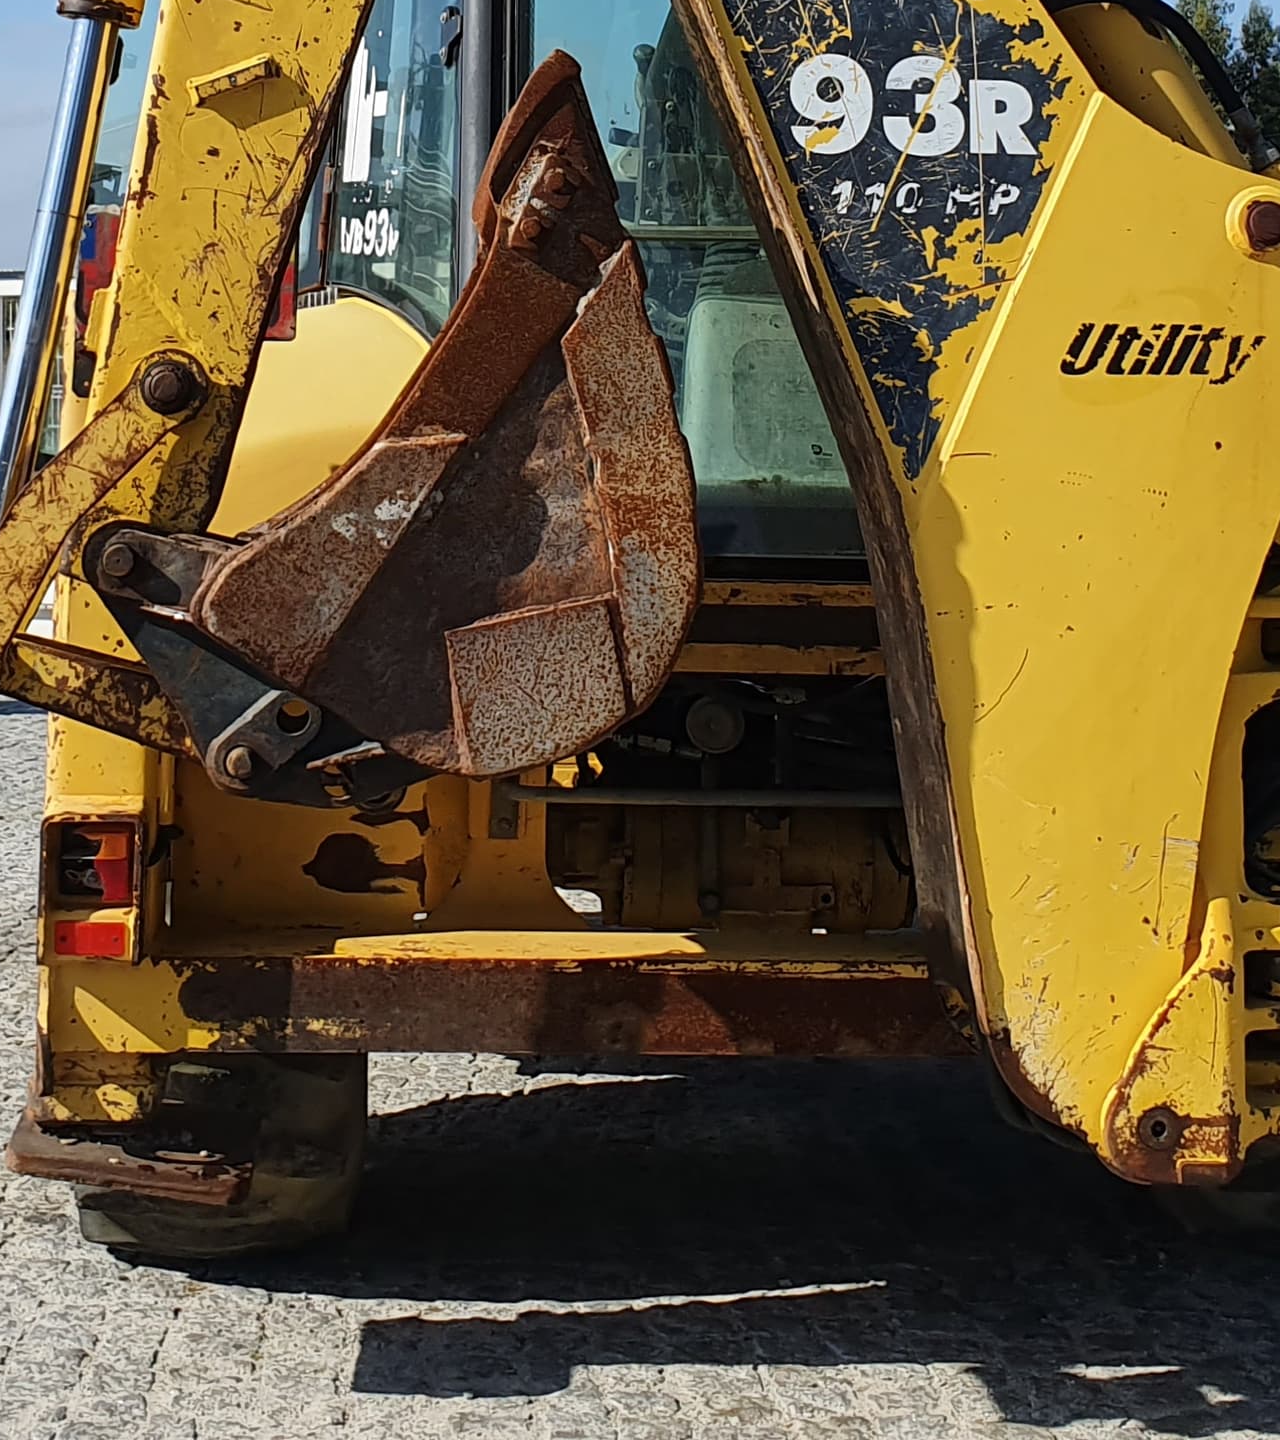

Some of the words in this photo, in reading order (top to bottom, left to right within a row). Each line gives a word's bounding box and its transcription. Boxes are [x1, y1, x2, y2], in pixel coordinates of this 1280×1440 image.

[789, 53, 1038, 157] 93R
[830, 180, 924, 216] 110
[1059, 322, 1267, 385] Utility
